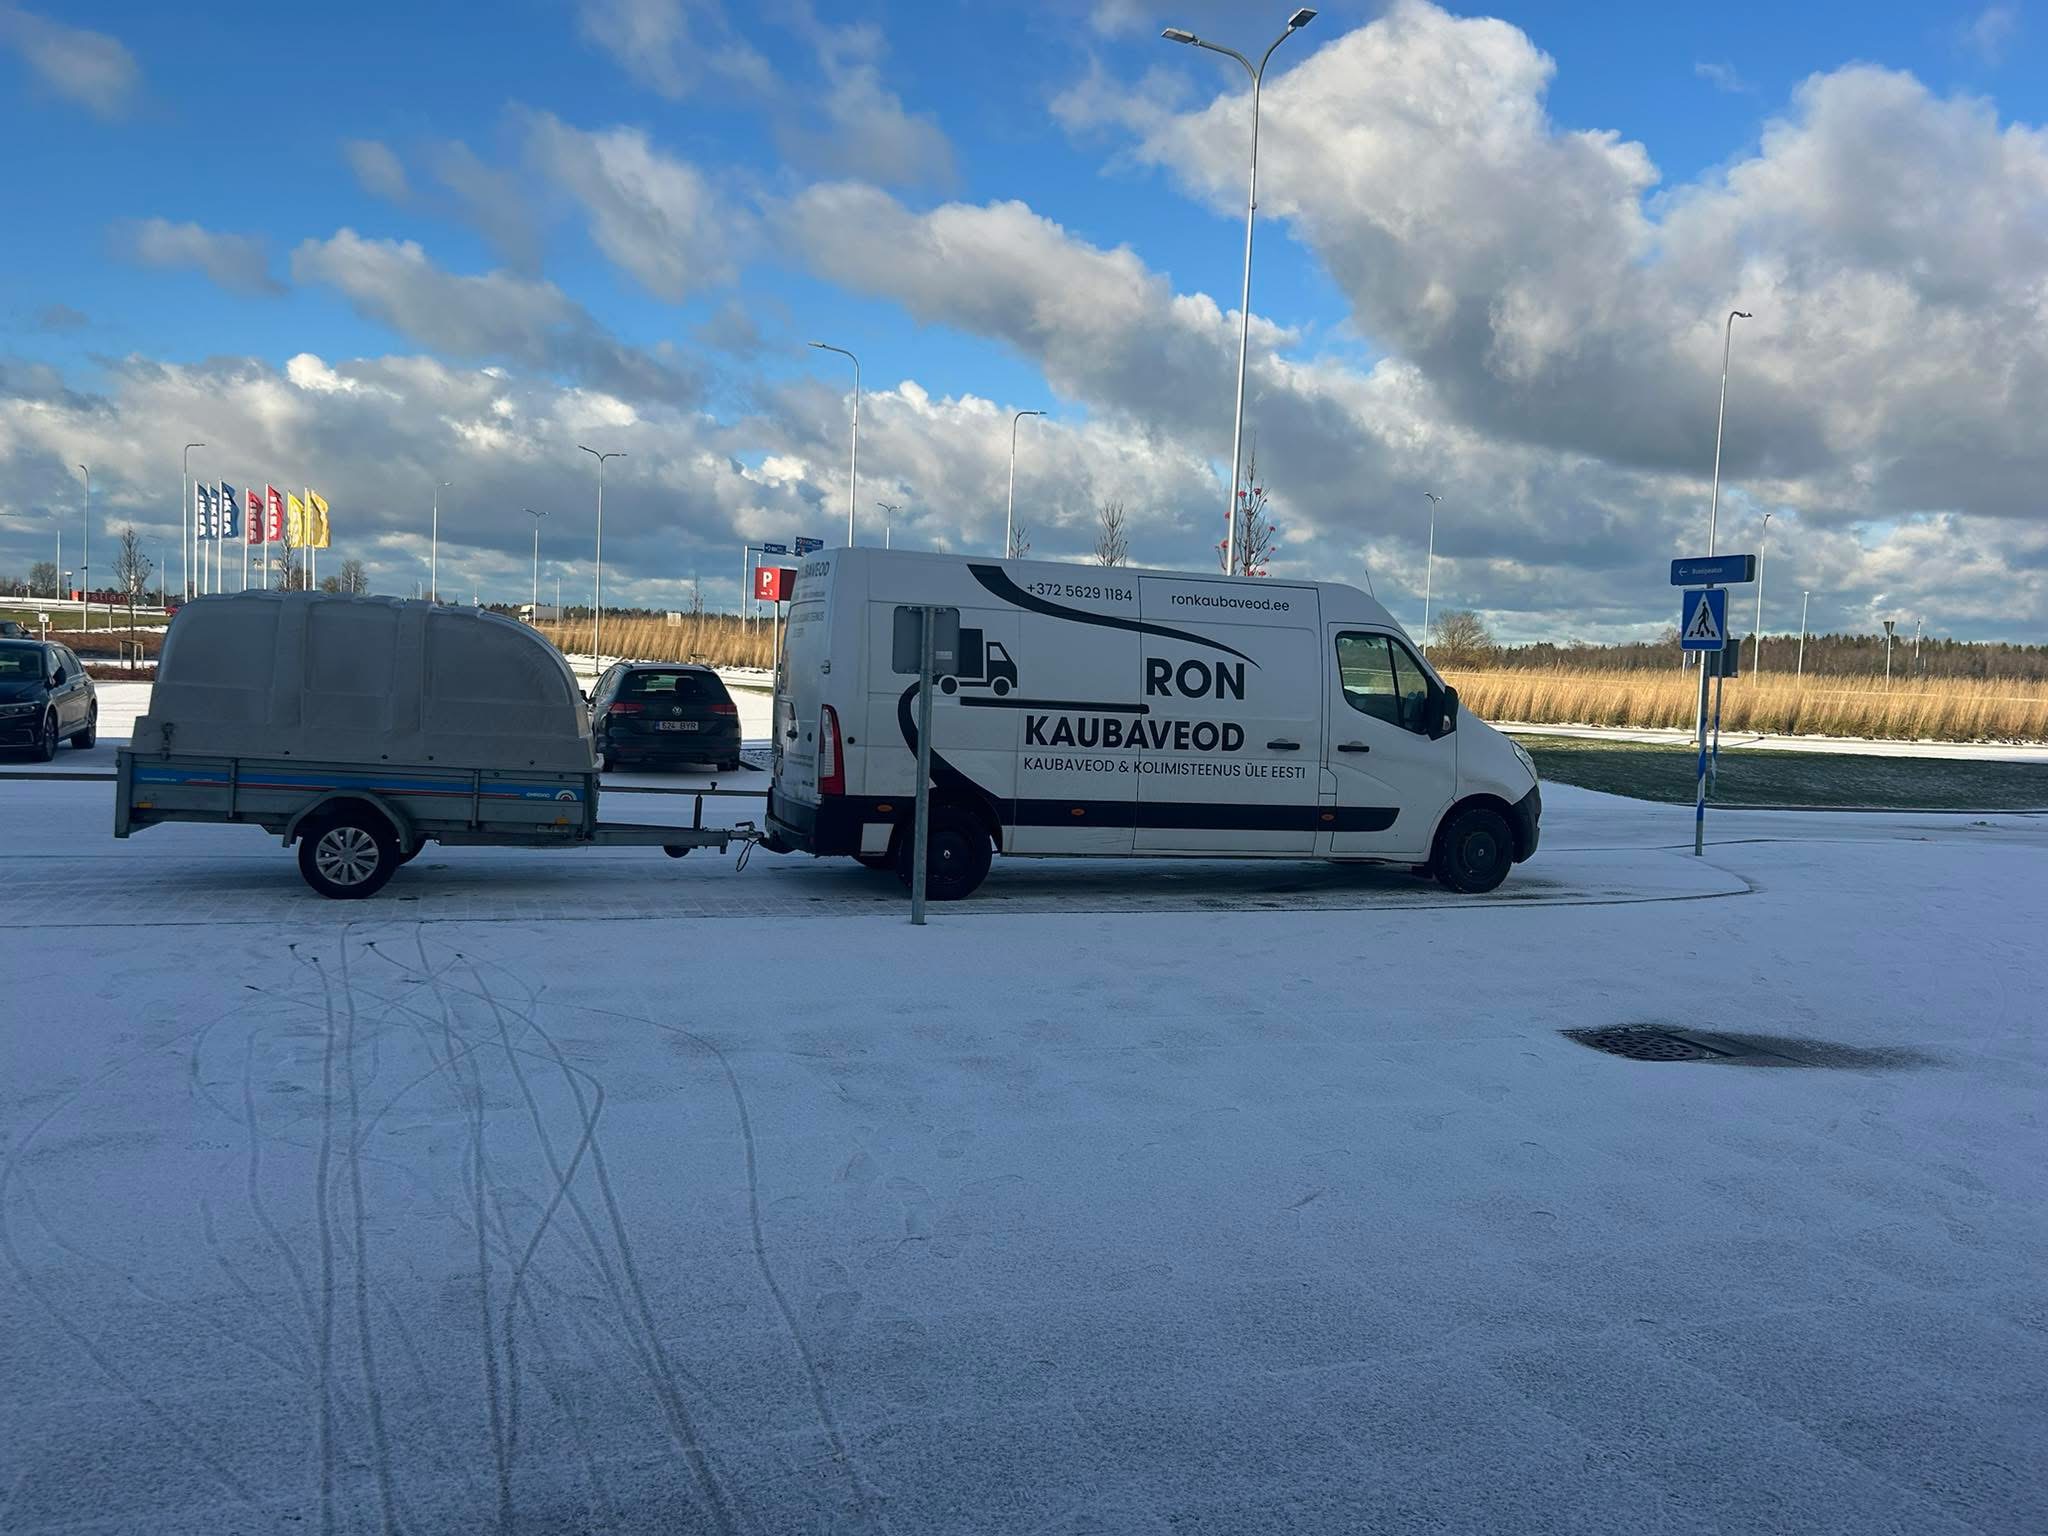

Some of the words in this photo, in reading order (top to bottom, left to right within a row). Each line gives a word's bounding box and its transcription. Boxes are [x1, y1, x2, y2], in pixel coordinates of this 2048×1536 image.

[199, 495, 207, 537] IKEA
[223, 492, 232, 536] IKEA
[249, 500, 257, 541] IKEA
[269, 495, 278, 538] IKEA
[763, 571, 773, 588] P
[1027, 582, 1061, 596] +372
[1066, 585, 1100, 599] 5629
[1105, 588, 1133, 601] 1184
[1171, 594, 1290, 611] ronkaubaveod.ee
[1146, 657, 1245, 700] RON
[1025, 715, 1245, 751] KAUBAVEOD
[1024, 757, 1115, 772] KAUBAVEOD
[1118, 760, 1129, 773] &
[1133, 761, 1241, 777] KOLIMISTEENUS
[1245, 762, 1268, 778] ÜLE
[1271, 765, 1306, 779] EESTI
